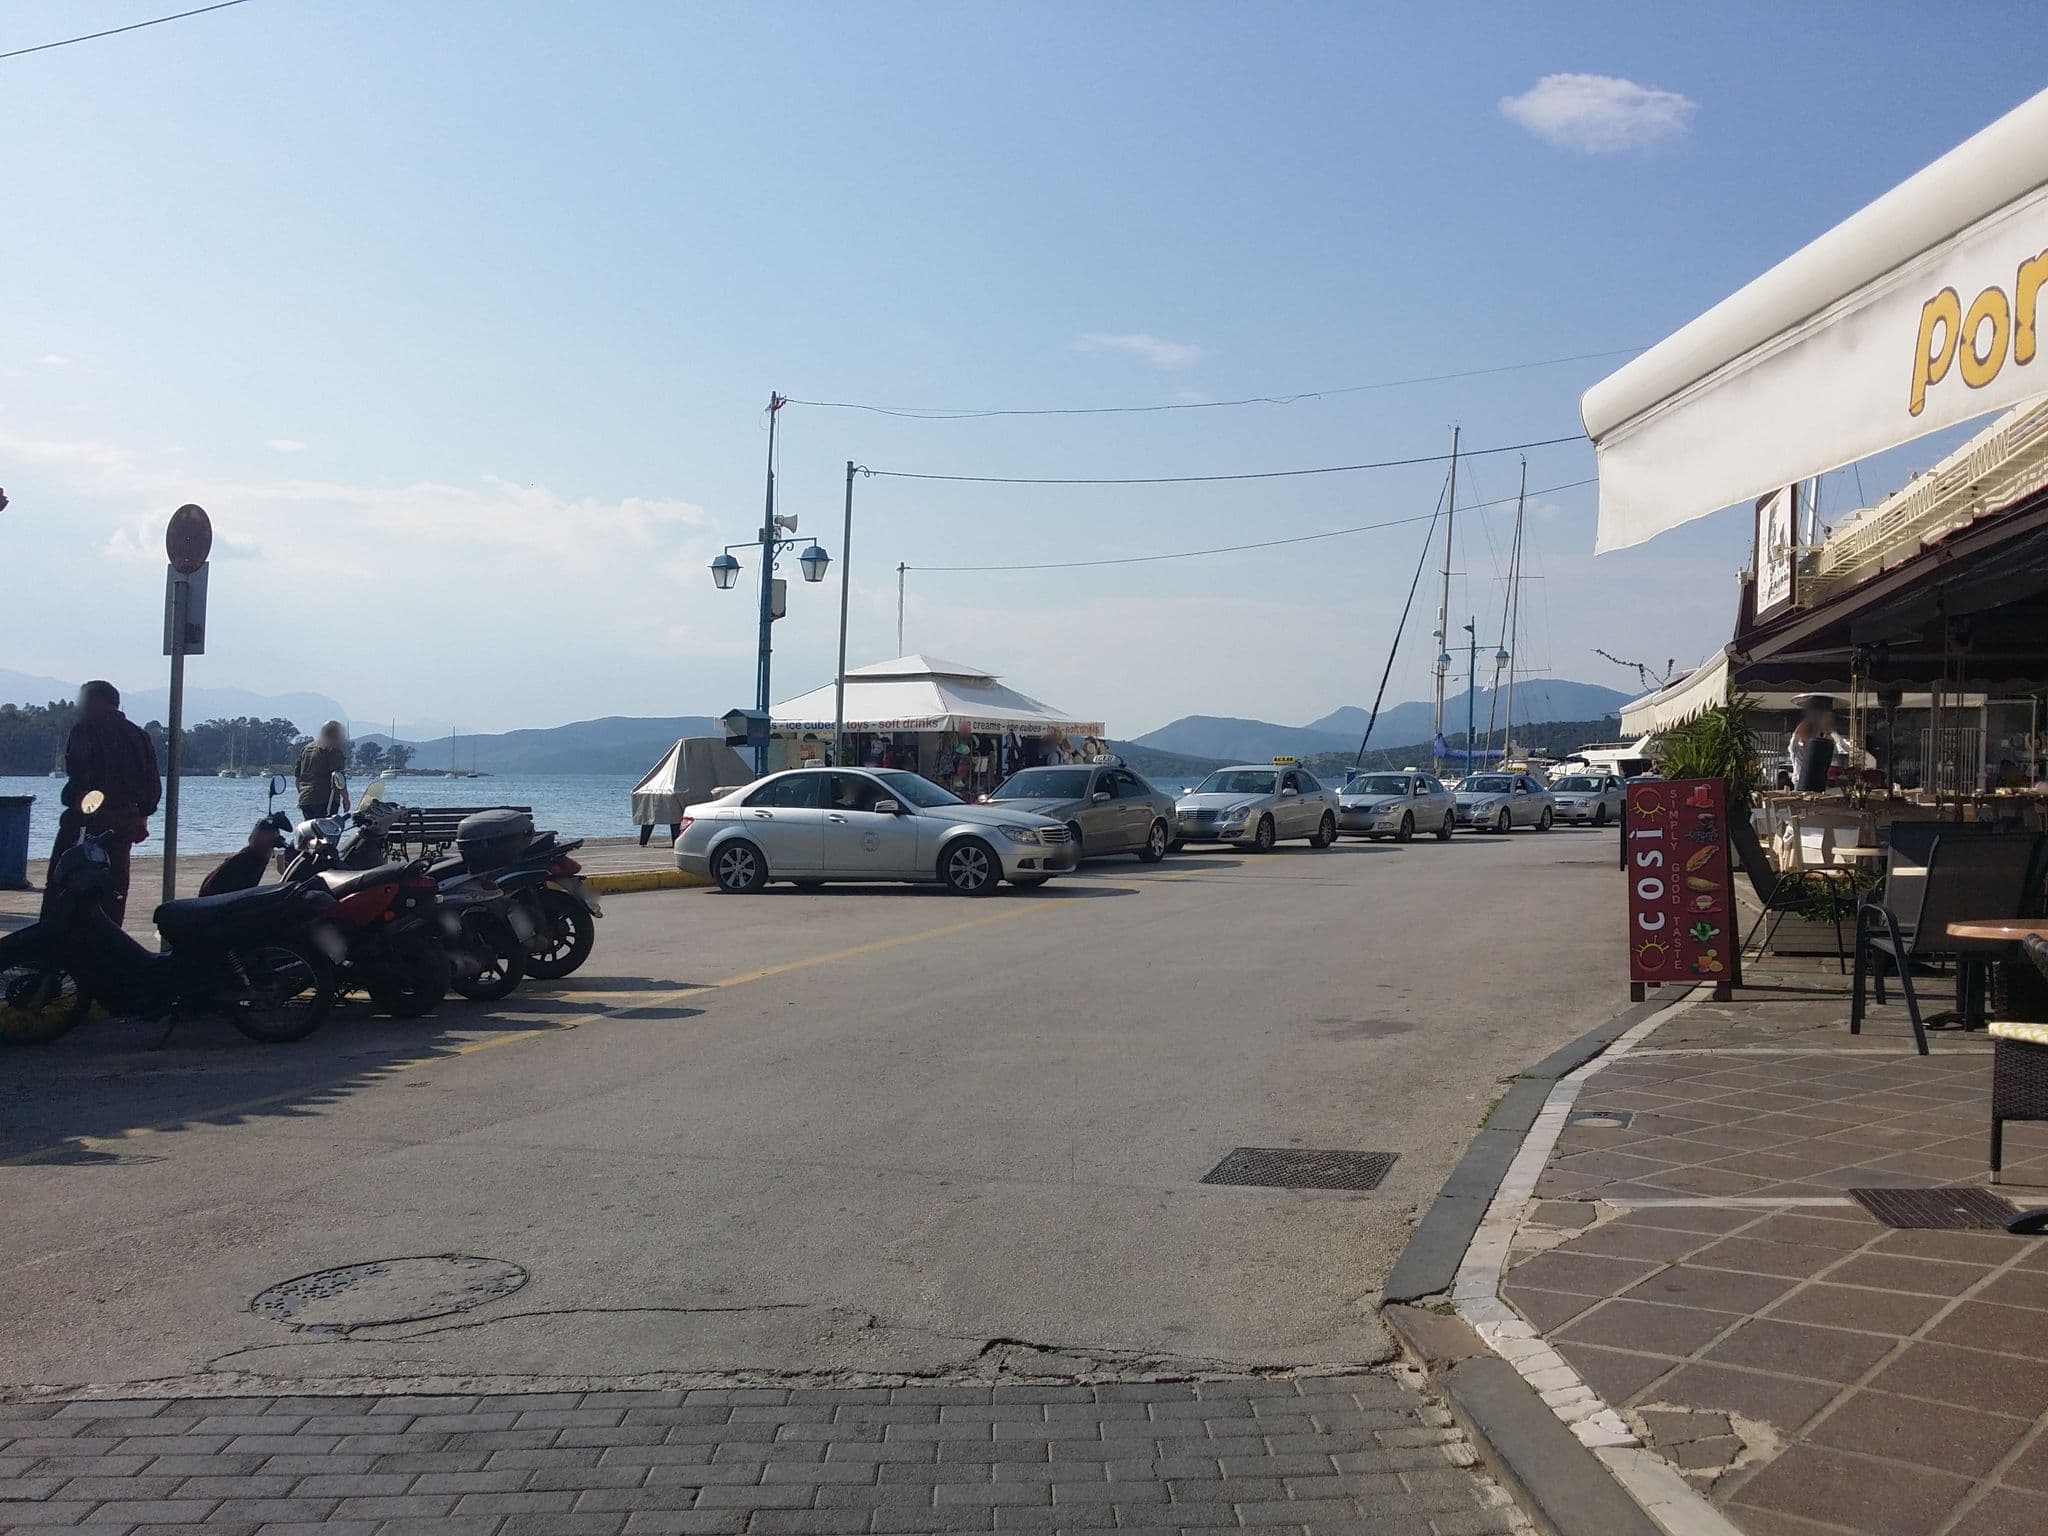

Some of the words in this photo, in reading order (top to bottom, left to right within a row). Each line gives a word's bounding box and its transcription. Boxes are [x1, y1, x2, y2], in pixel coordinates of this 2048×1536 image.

[786, 720, 802, 730] ice
[804, 720, 836, 730] cubes
[846, 720, 869, 731] toys
[879, 719, 900, 729] soft
[902, 718, 939, 729] drinks
[1669, 789, 1679, 851] SIMPLY
[1671, 863, 1681, 904] GOOD
[1672, 916, 1682, 970] TASTE
